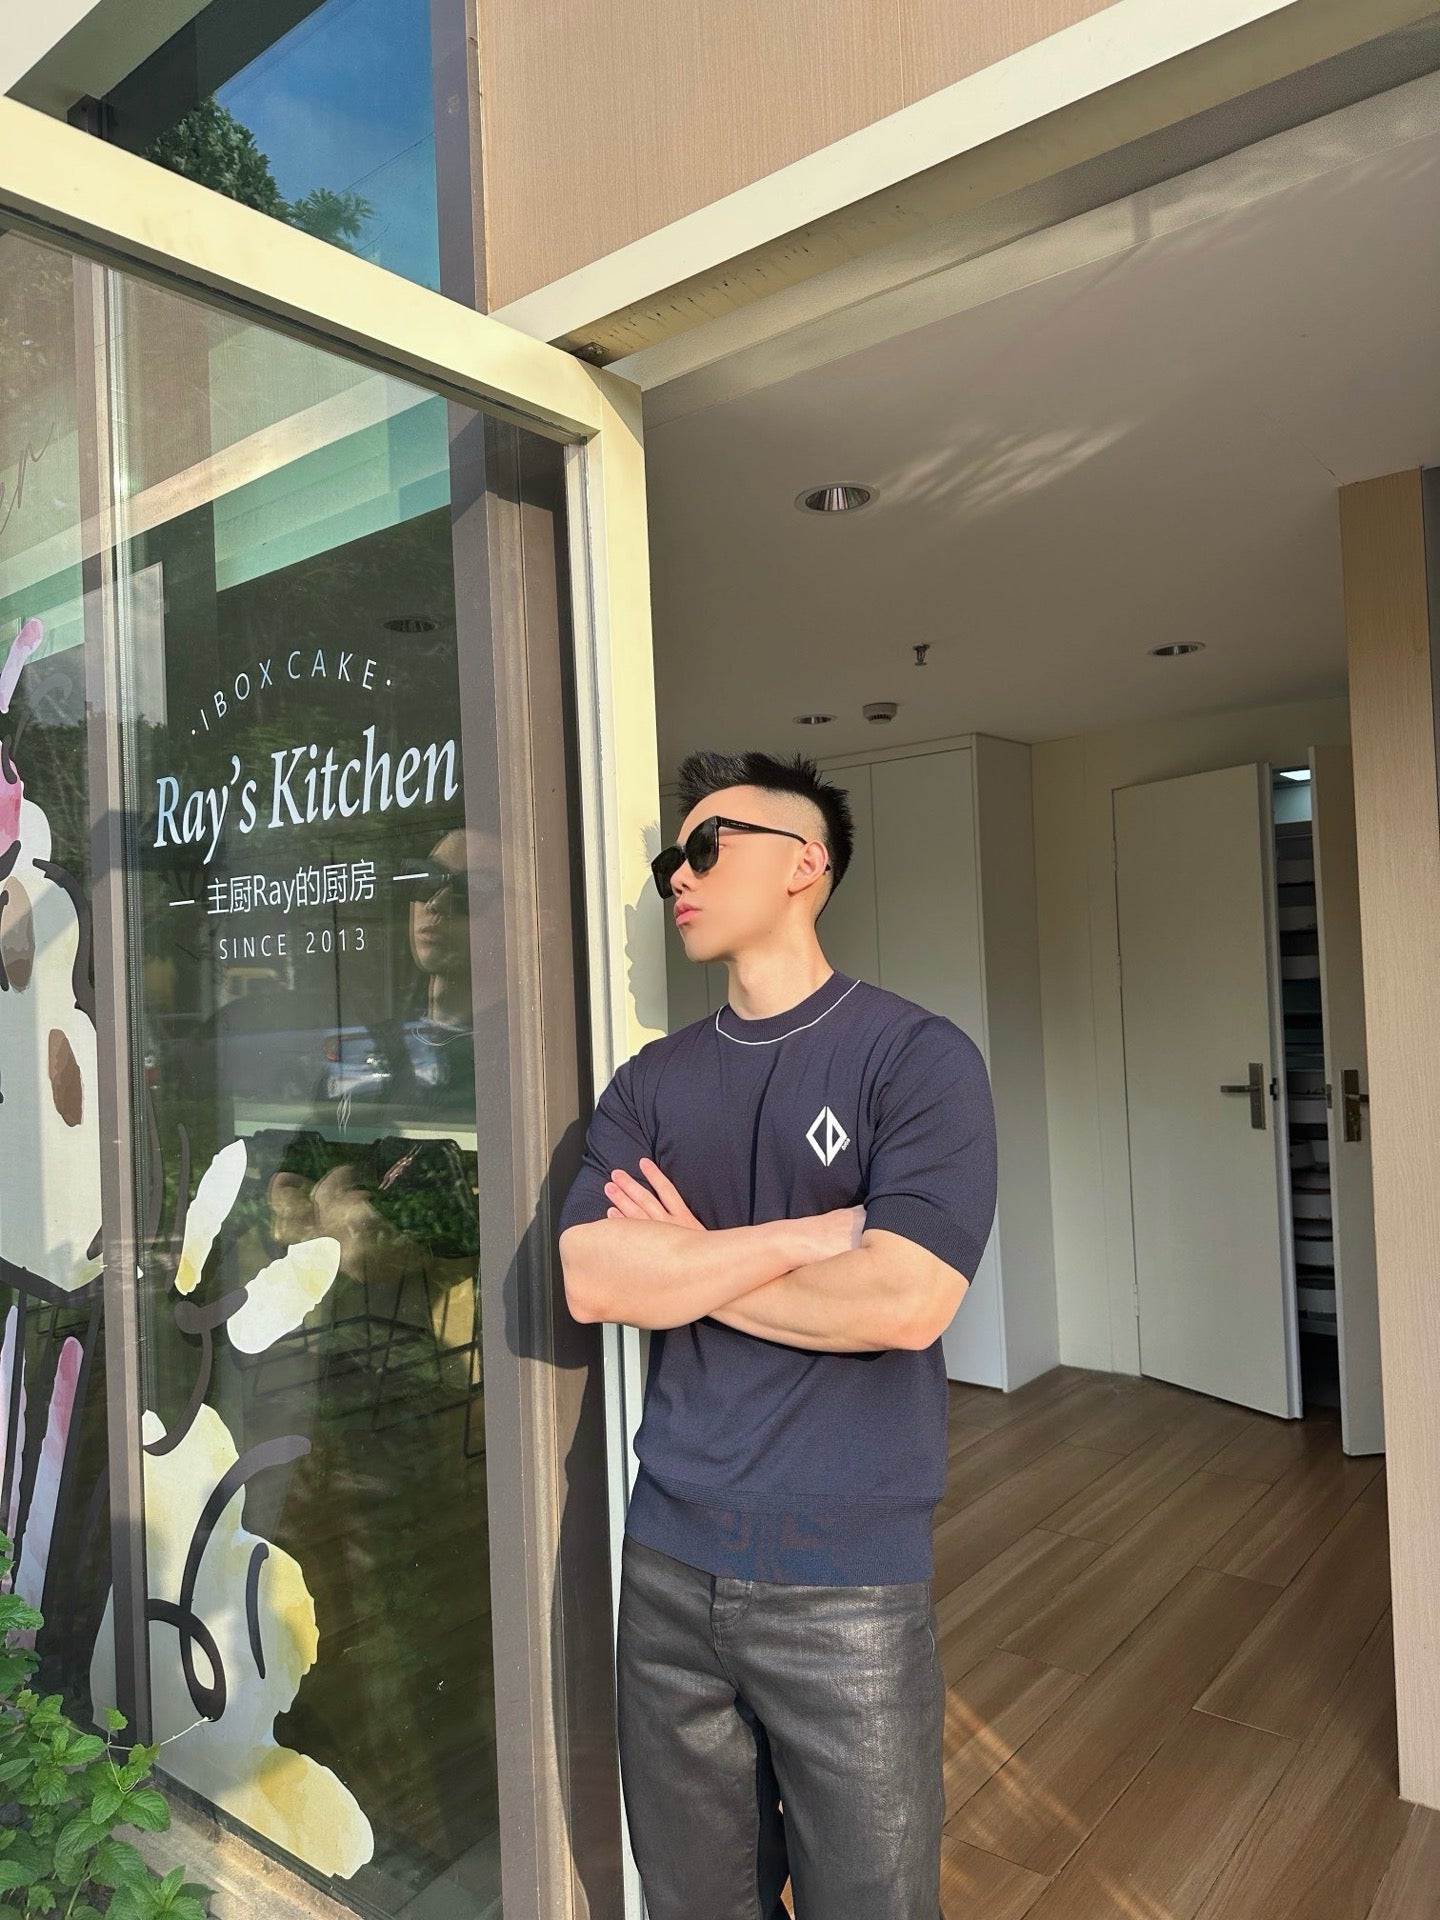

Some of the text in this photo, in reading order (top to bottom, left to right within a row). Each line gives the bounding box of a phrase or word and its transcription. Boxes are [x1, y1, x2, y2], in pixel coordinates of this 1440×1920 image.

[153, 724, 459, 865] Ray's Kitchen
[206, 858, 377, 915] 主厨Ray的厨房
[219, 927, 366, 960] SINCE 2013
